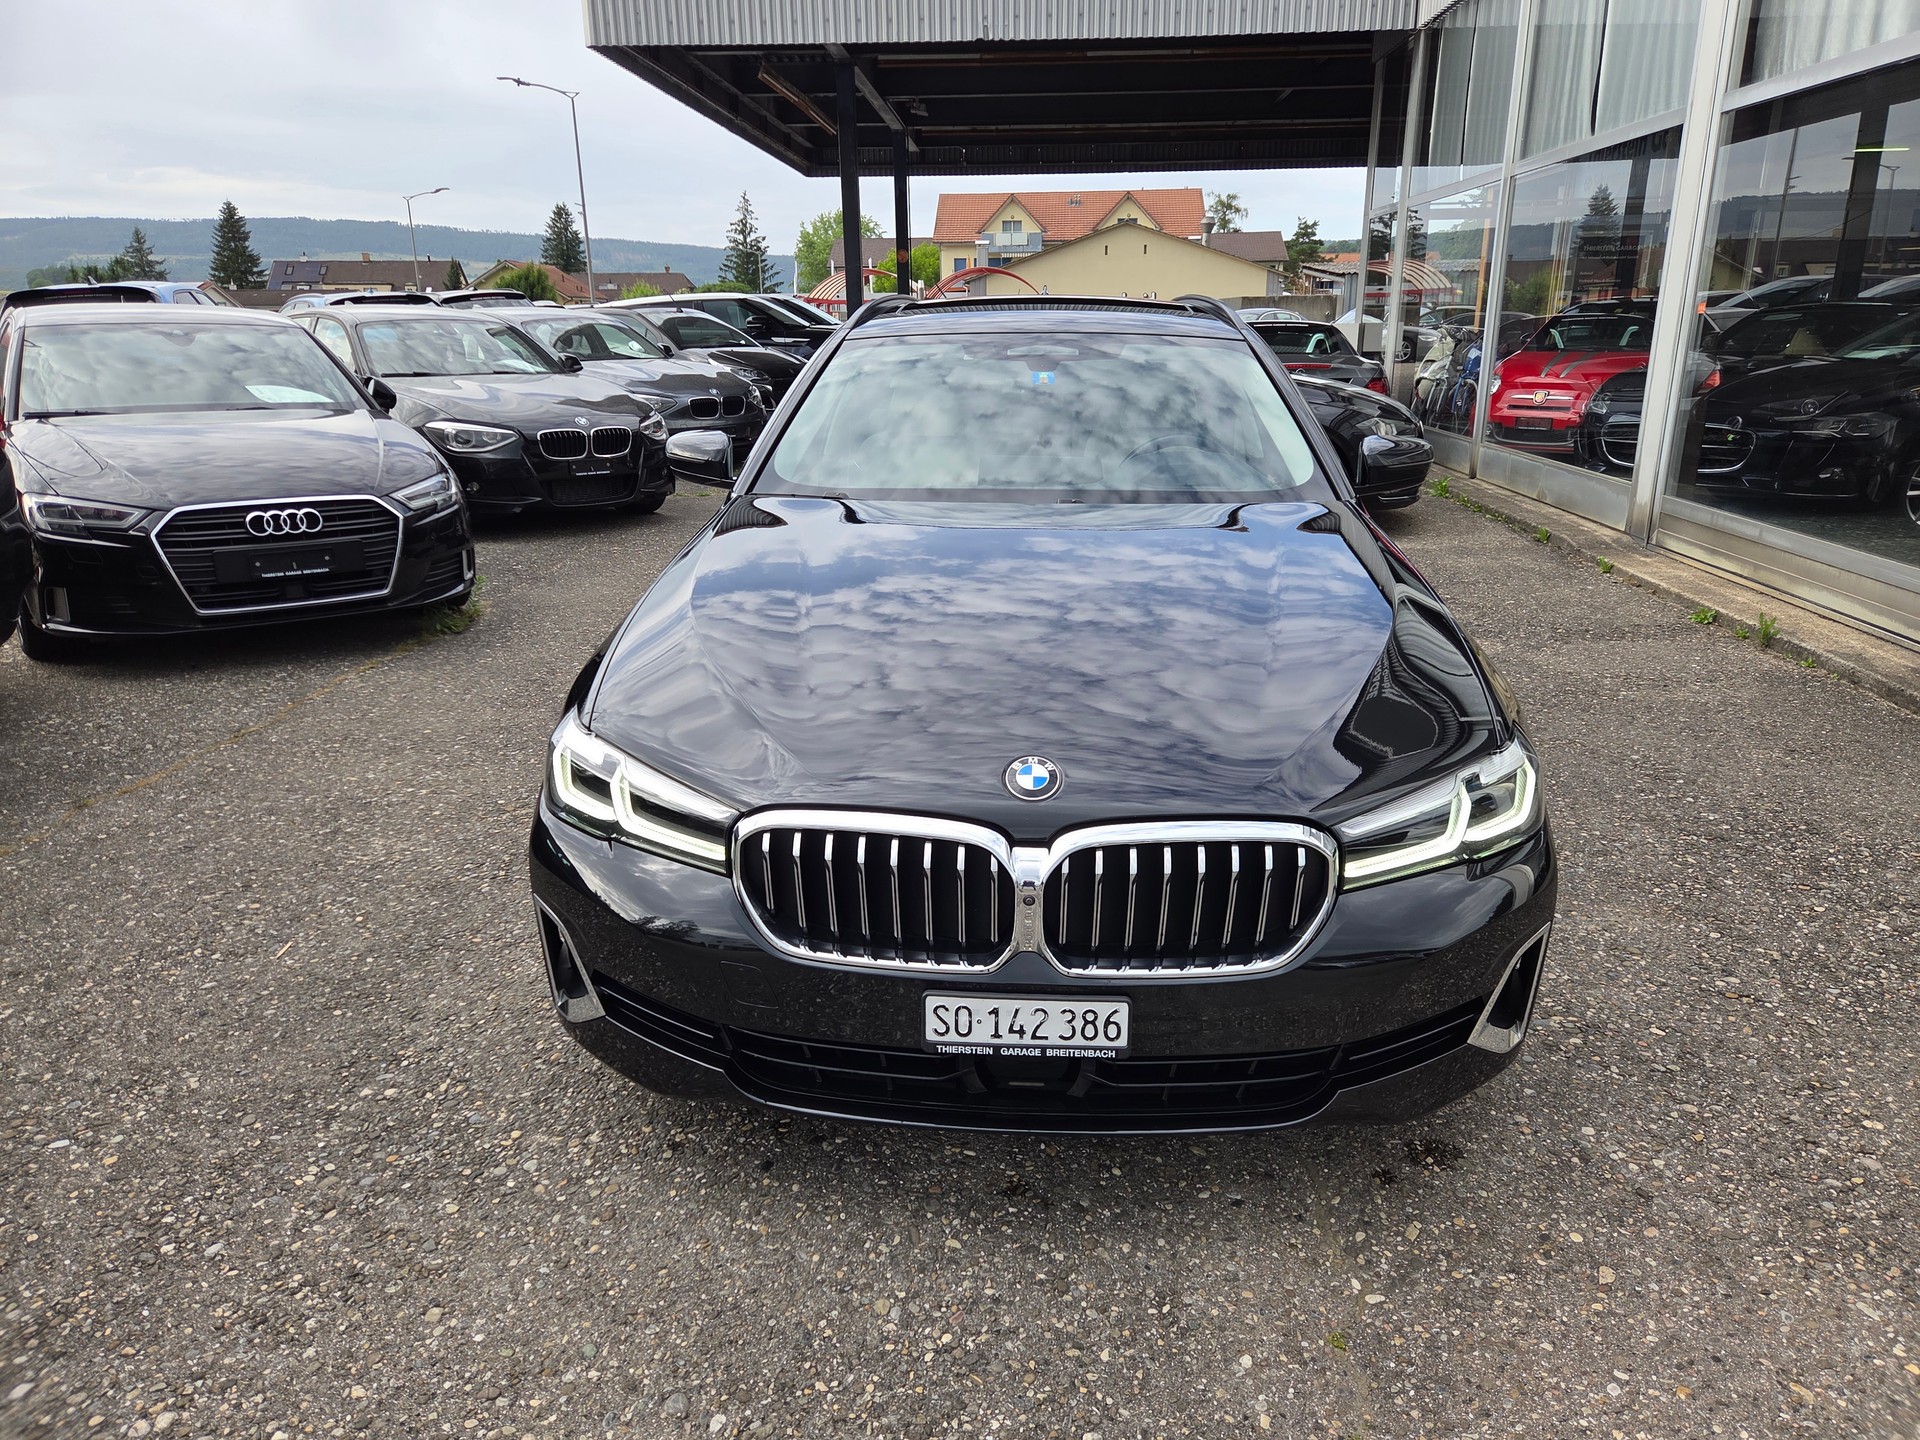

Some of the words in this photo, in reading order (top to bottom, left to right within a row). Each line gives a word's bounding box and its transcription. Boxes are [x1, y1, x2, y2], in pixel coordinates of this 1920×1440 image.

[1011, 757, 1055, 771] BMW
[936, 1045, 993, 1055] THIERSTEIN
[1000, 1047, 1041, 1057] GARAGE
[1046, 1048, 1116, 1058] BREITENBACH
